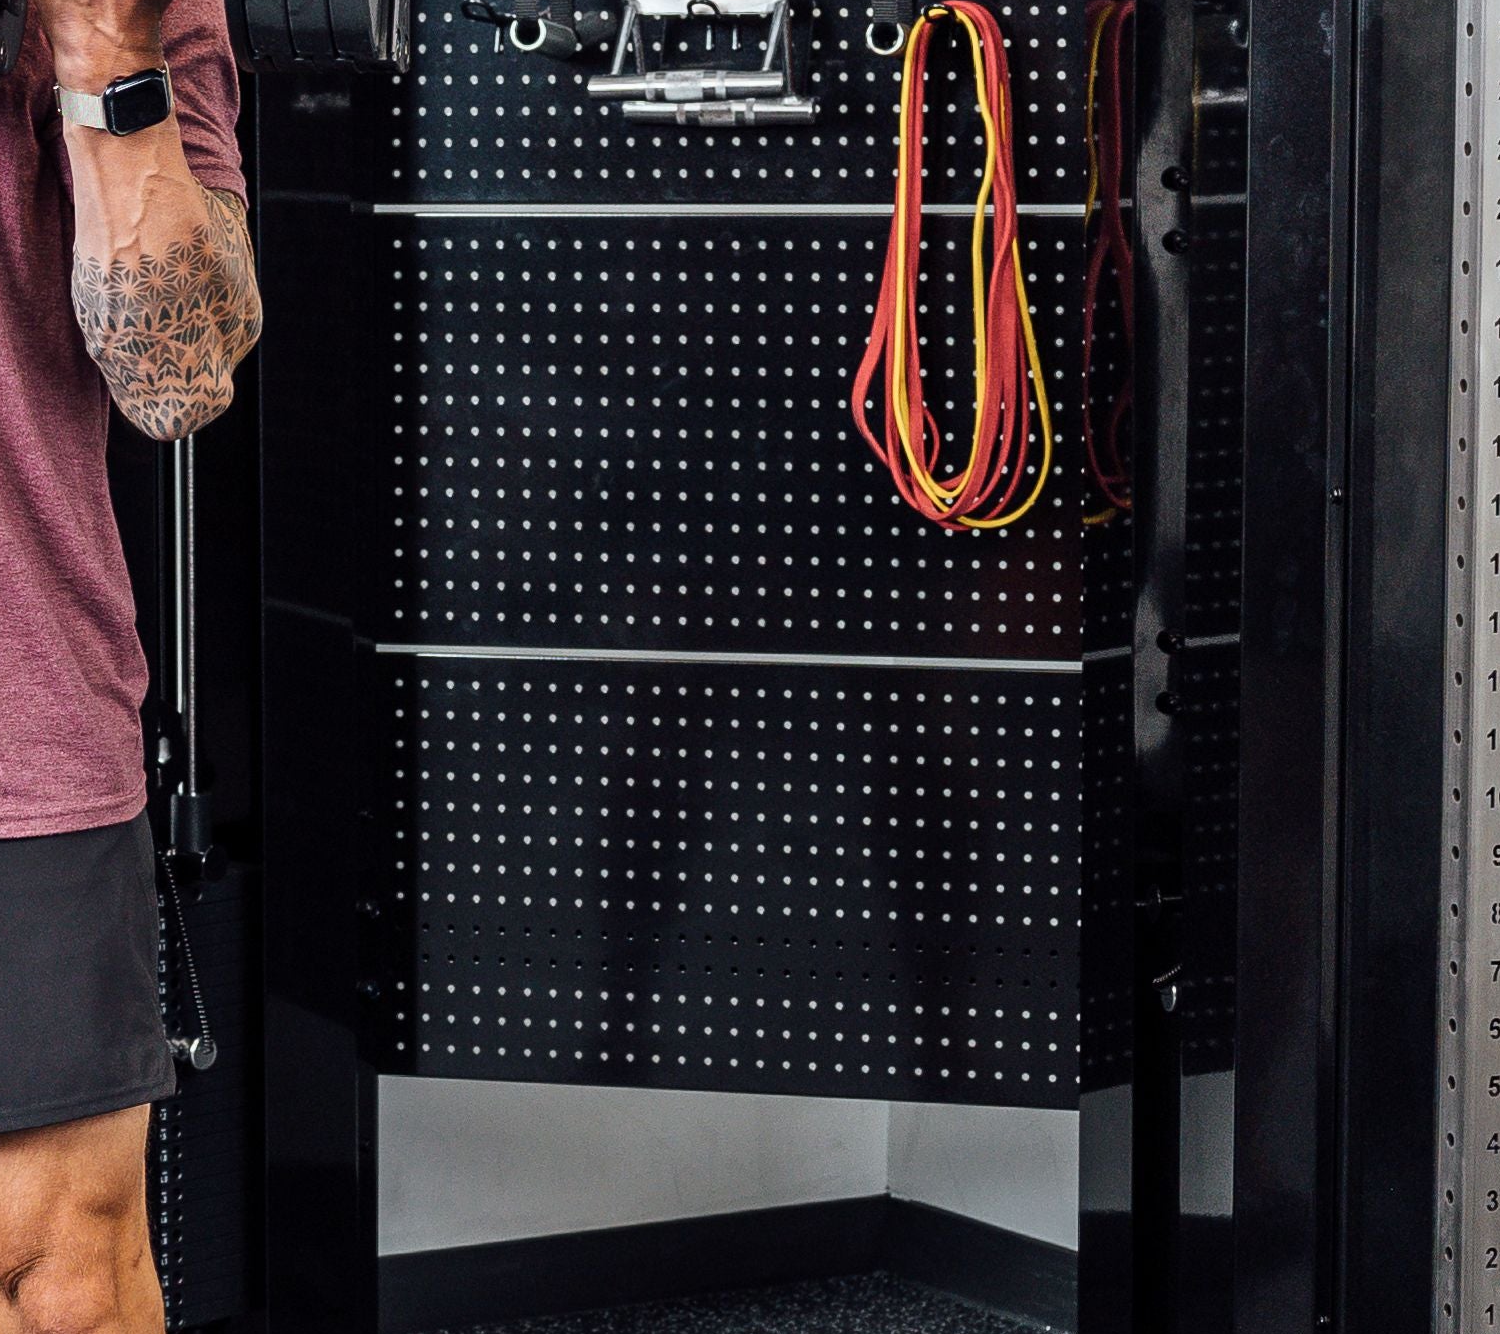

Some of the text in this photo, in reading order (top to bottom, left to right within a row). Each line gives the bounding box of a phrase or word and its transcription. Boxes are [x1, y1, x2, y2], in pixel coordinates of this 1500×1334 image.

[1488, 1075, 1500, 1097] 5
[1486, 1132, 1500, 1155] 4
[1486, 1189, 1499, 1212] 3
[1485, 1247, 1498, 1269] 2
[1484, 1303, 1494, 1326] 1
